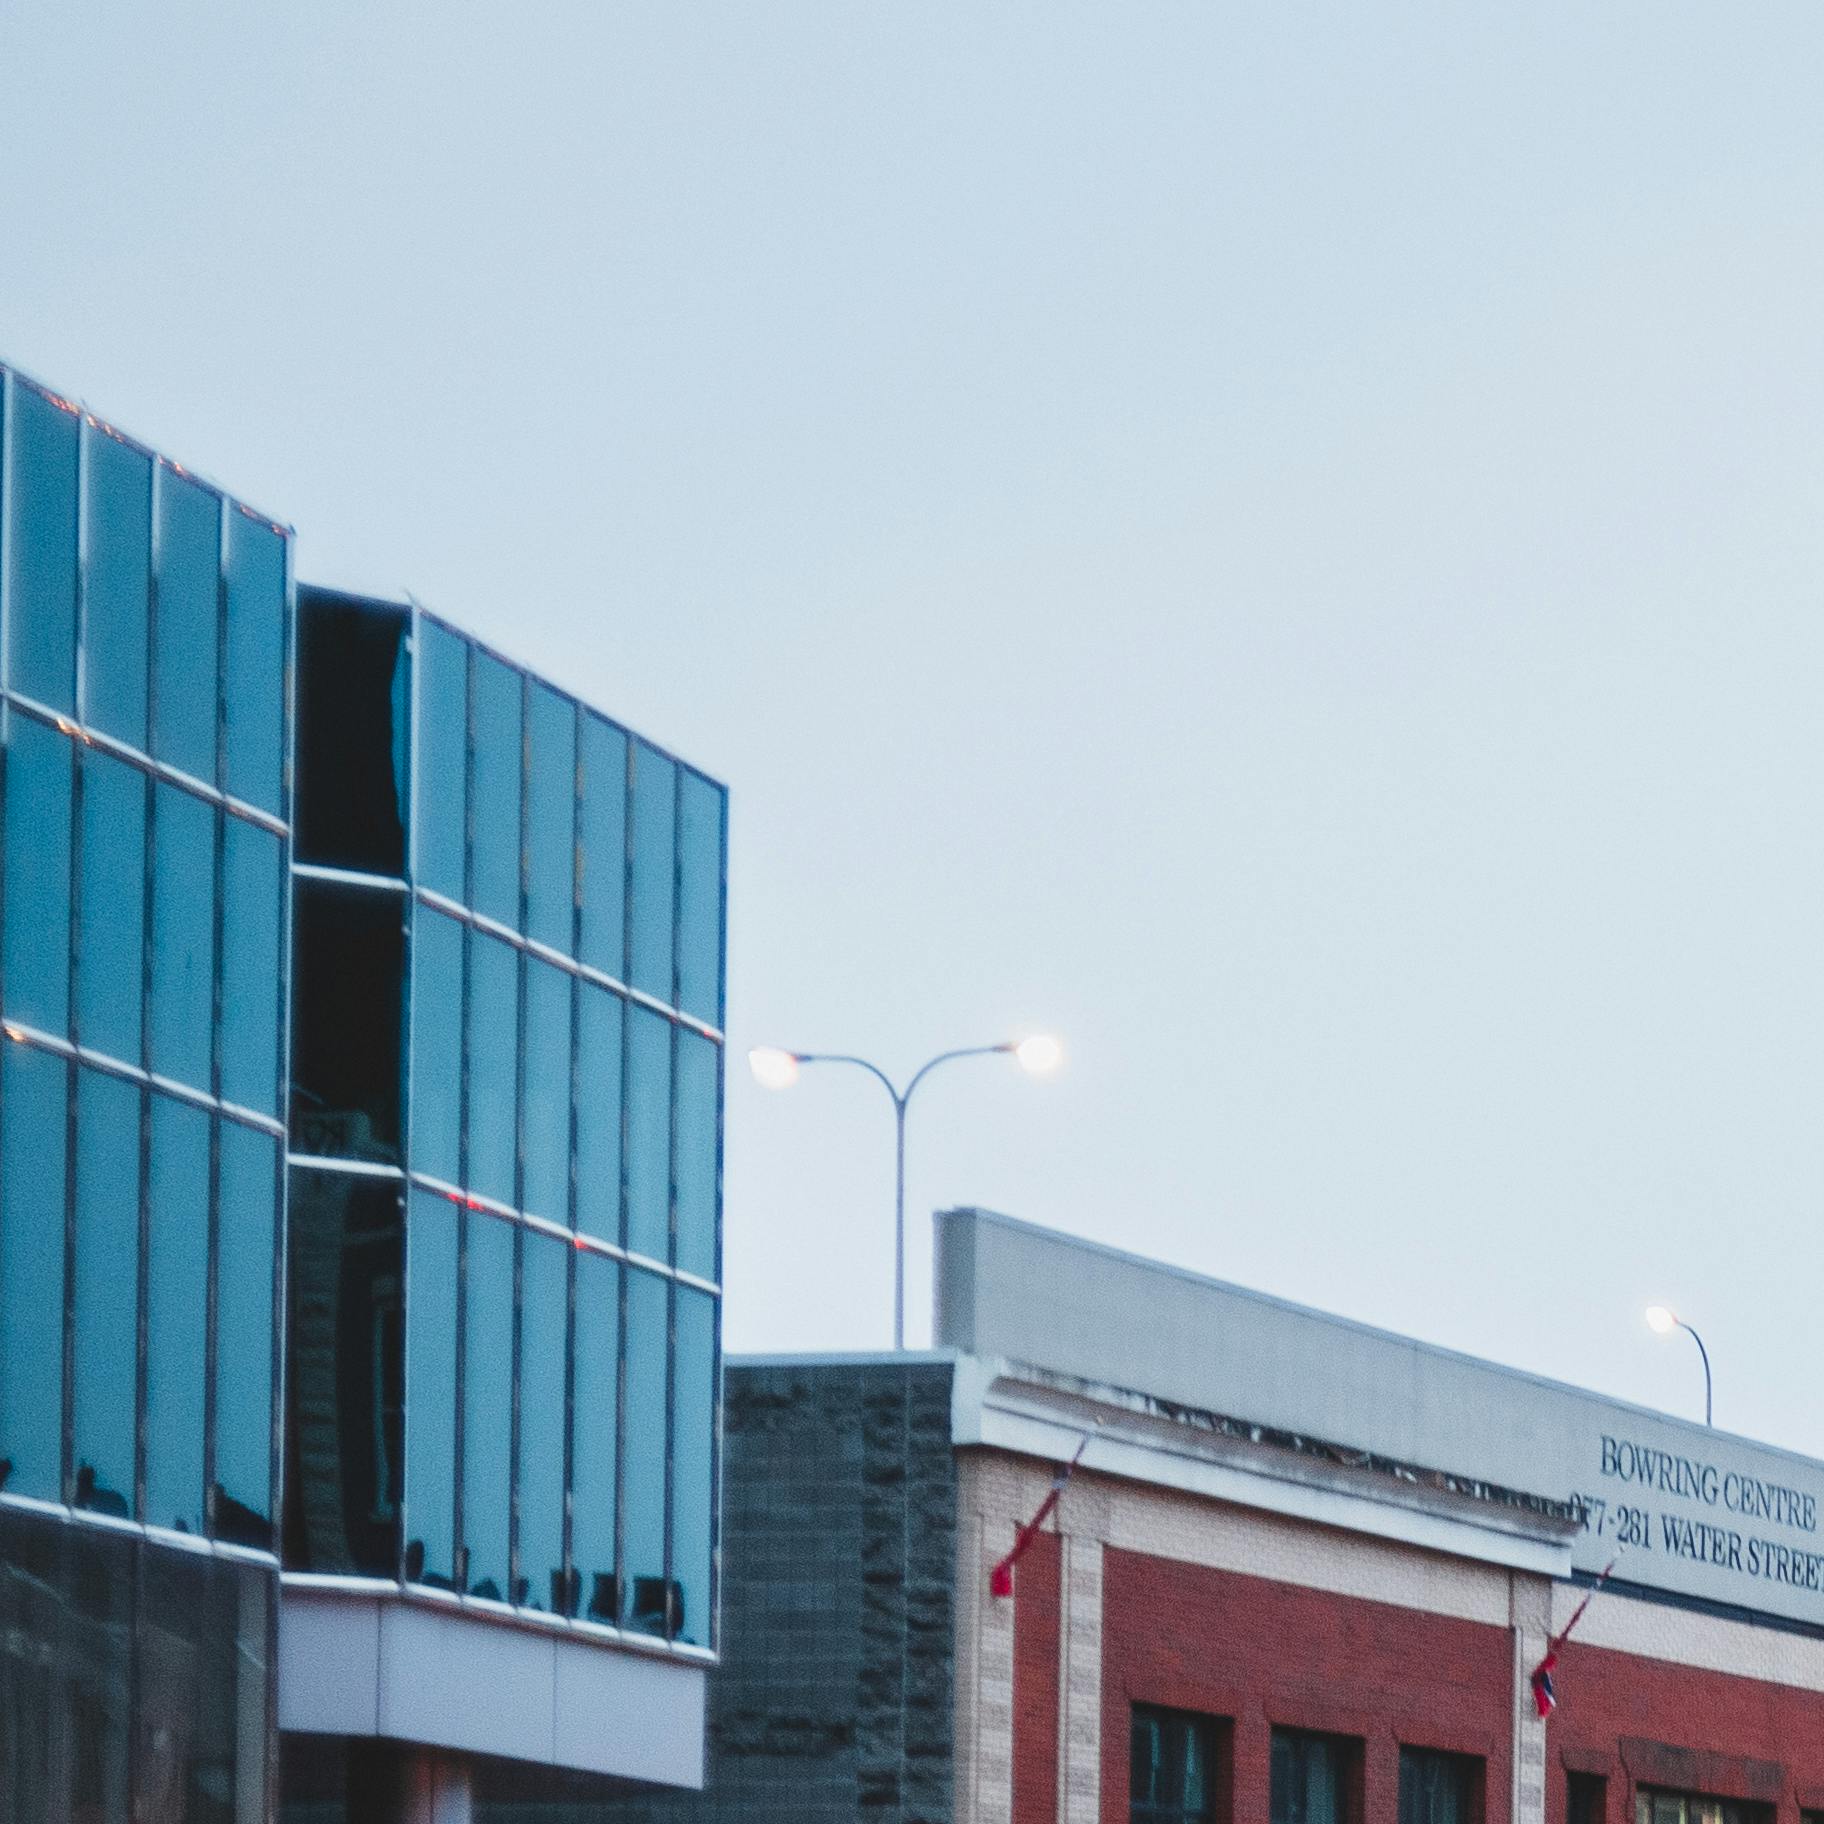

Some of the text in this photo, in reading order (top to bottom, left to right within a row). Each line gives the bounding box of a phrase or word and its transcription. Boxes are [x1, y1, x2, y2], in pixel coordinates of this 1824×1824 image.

[1600, 1435, 1817, 1533] BOWRING CENTRE
[1661, 1513, 1743, 1570] WATER
